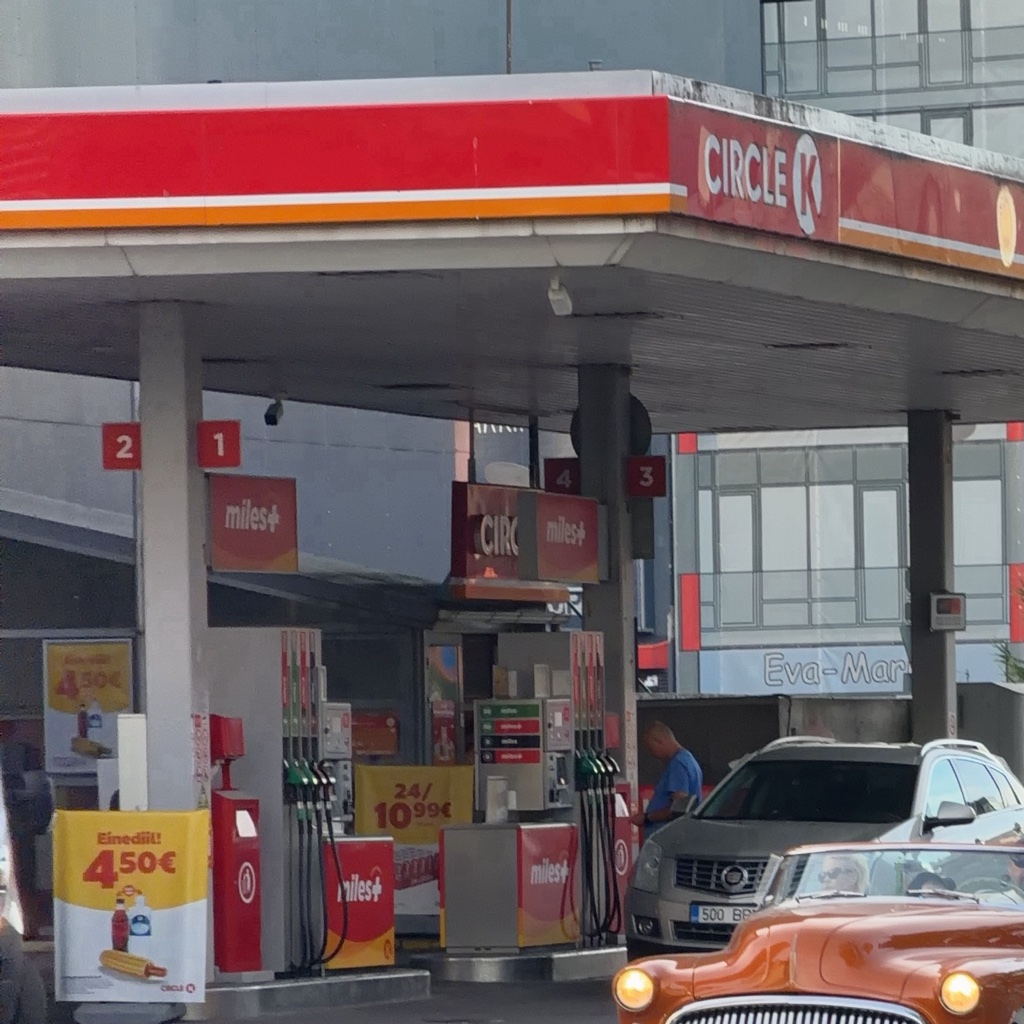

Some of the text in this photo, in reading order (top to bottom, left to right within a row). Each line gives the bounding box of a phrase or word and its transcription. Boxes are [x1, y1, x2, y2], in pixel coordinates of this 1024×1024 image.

[704, 134, 787, 208] CIRCLE
[116, 435, 133, 458] 2
[213, 433, 224, 456] 1
[556, 469, 572, 488] 4
[639, 466, 654, 487] 3
[224, 499, 280, 533] miles+
[546, 516, 586, 546] miles+
[530, 858, 569, 885] miles+
[702, 908, 724, 921] 500
